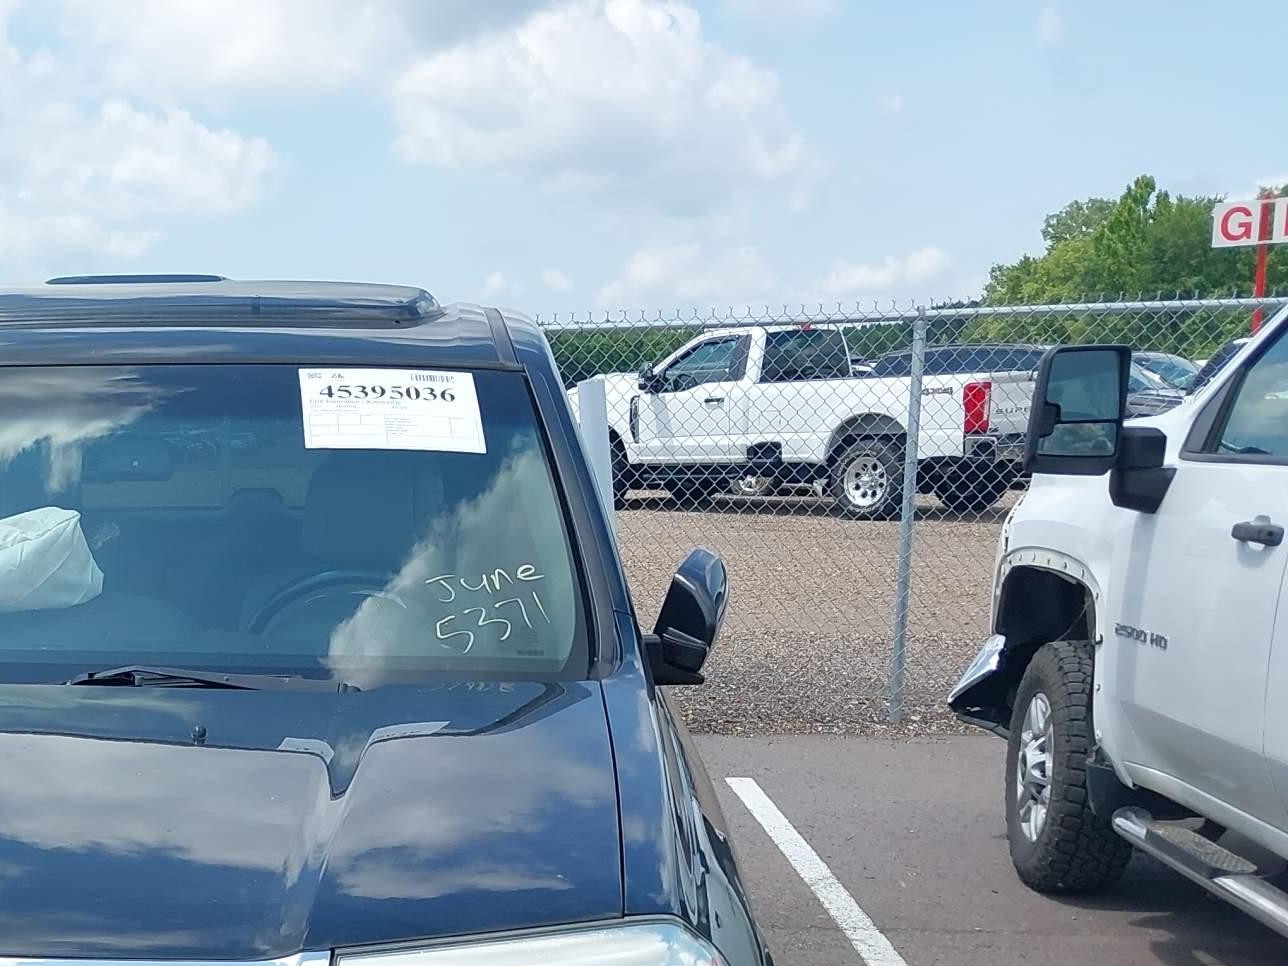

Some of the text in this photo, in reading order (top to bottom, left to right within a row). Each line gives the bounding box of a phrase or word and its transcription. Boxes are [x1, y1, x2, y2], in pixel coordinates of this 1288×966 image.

[319, 385, 456, 402] 45395036
[436, 592, 550, 654] 5371
[1114, 622, 1147, 643] 2500
